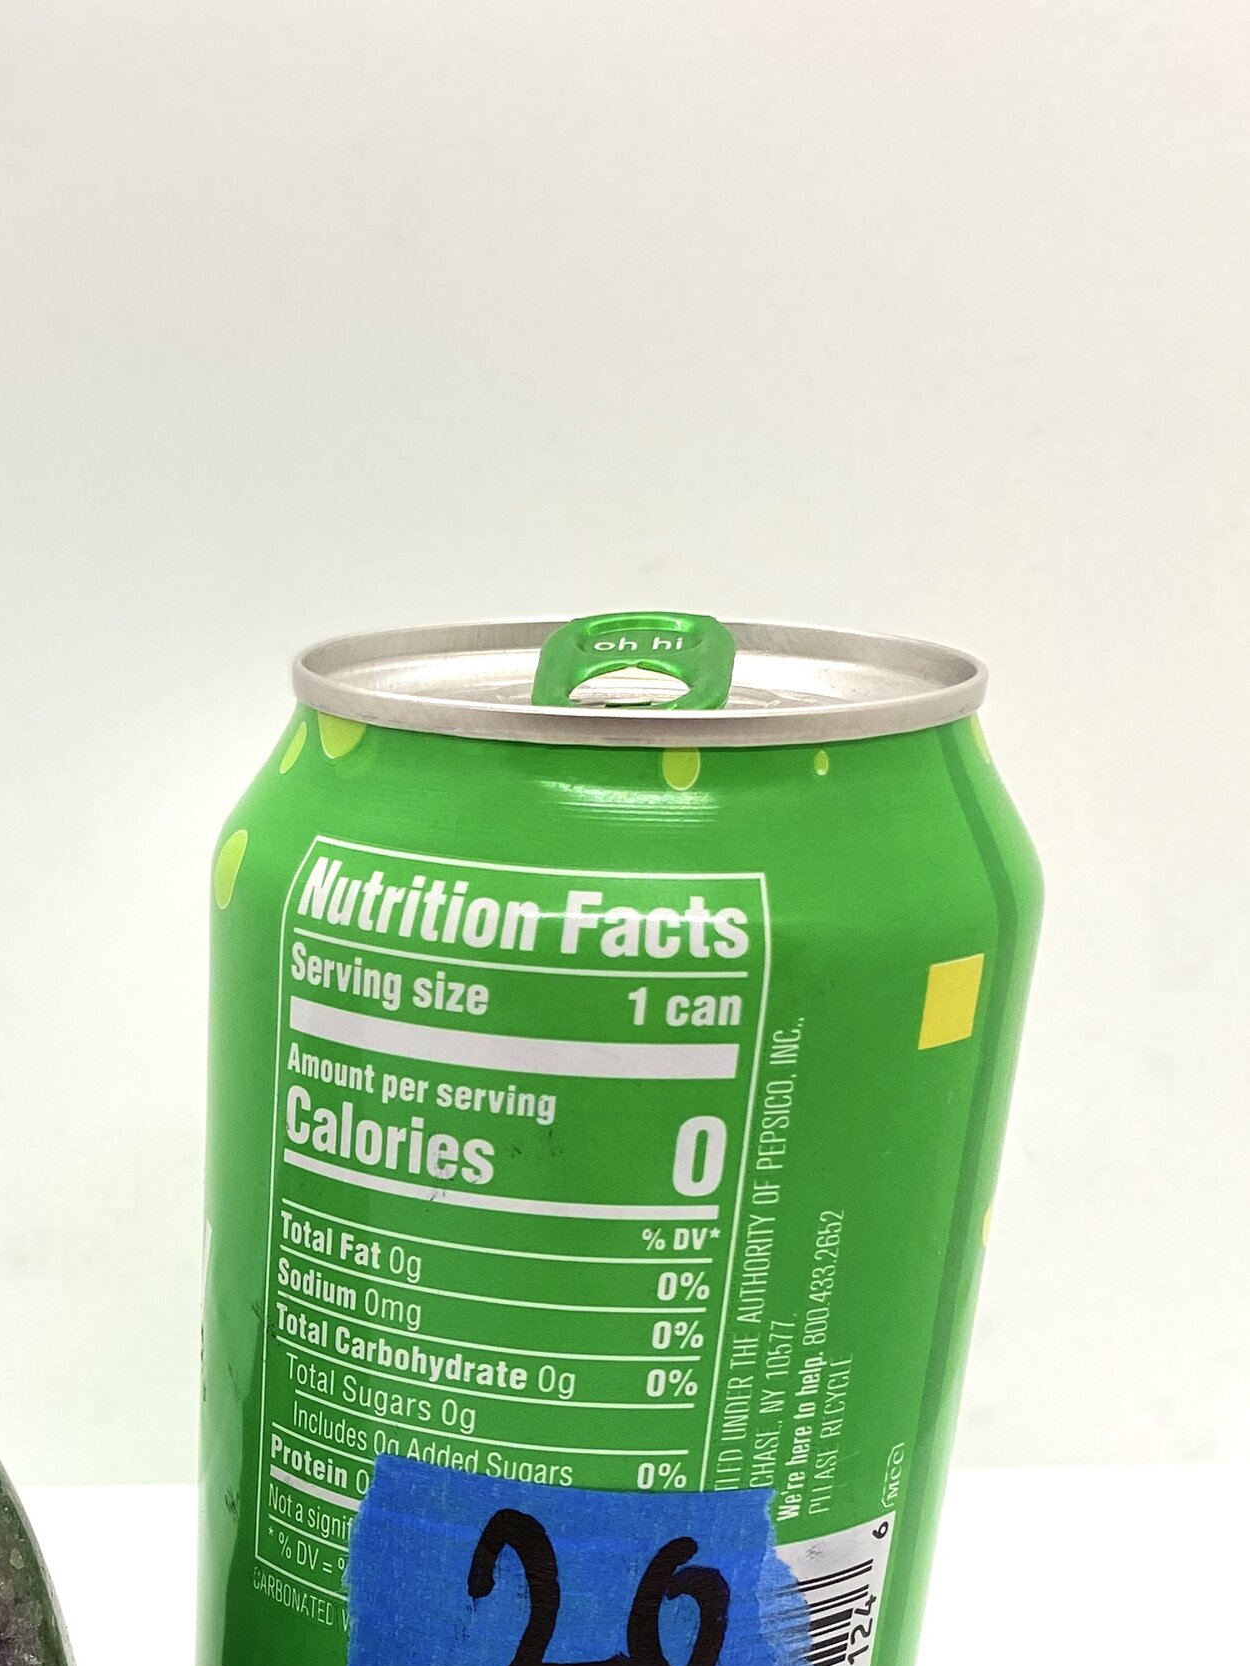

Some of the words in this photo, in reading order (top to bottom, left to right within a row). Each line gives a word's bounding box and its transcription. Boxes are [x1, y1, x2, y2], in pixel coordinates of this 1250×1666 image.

[594, 637, 638, 651] oh
[652, 637, 683, 650] hi
[297, 856, 540, 951] Nutrition
[560, 891, 748, 959] Facts
[291, 941, 401, 1011] Serving
[413, 971, 489, 1015] size
[628, 986, 648, 1026] 1
[666, 994, 742, 1027] can
[287, 1042, 374, 1093] Amount
[382, 1071, 428, 1103] per
[437, 1084, 556, 1125] serving
[285, 1085, 494, 1185] Calories
[672, 1115, 727, 1197] 0
[756, 1073, 797, 1171] PEPSICO,
[752, 1180, 781, 1205] OF
[281, 1210, 332, 1255] Total
[340, 1232, 381, 1269] Fat
[390, 1246, 422, 1283] 0g
[657, 1272, 709, 1301] 0%
[642, 1228, 665, 1250] %
[737, 1214, 776, 1323] AUTHORITY
[278, 1257, 356, 1310] Sodium
[365, 1288, 422, 1331] 0mg
[652, 1321, 703, 1349] 0%
[802, 1209, 845, 1345] 800.433.2652
[276, 1302, 327, 1347] Total
[335, 1326, 527, 1390] Carbohydrate
[538, 1365, 575, 1400] 0g
[646, 1369, 698, 1397] 0%
[730, 1333, 759, 1369] THE
[794, 1351, 827, 1396] help.
[286, 1352, 334, 1395] Total
[343, 1375, 431, 1421] Sugars
[442, 1400, 476, 1434] 0g
[721, 1376, 754, 1441] UNDER
[759, 1389, 786, 1414] NY
[793, 1402, 816, 1420] to
[819, 1355, 853, 1439] RECYCLE
[270, 1434, 348, 1488] Protein
[356, 1469, 369, 1495] 0
[293, 1401, 367, 1451] Includes
[407, 1438, 479, 1475] Added
[486, 1451, 572, 1485] Sugars
[637, 1463, 687, 1489] 0%
[784, 1426, 813, 1466] here
[887, 1450, 904, 1501] MCC
[269, 1483, 292, 1518] Not
[296, 1503, 303, 1523] a
[776, 1471, 806, 1521] We're
[808, 1445, 839, 1515] PLEASE
[297, 1540, 319, 1570] DV
[872, 1521, 889, 1539] 6
[253, 1567, 334, 1625] CARBONATED
